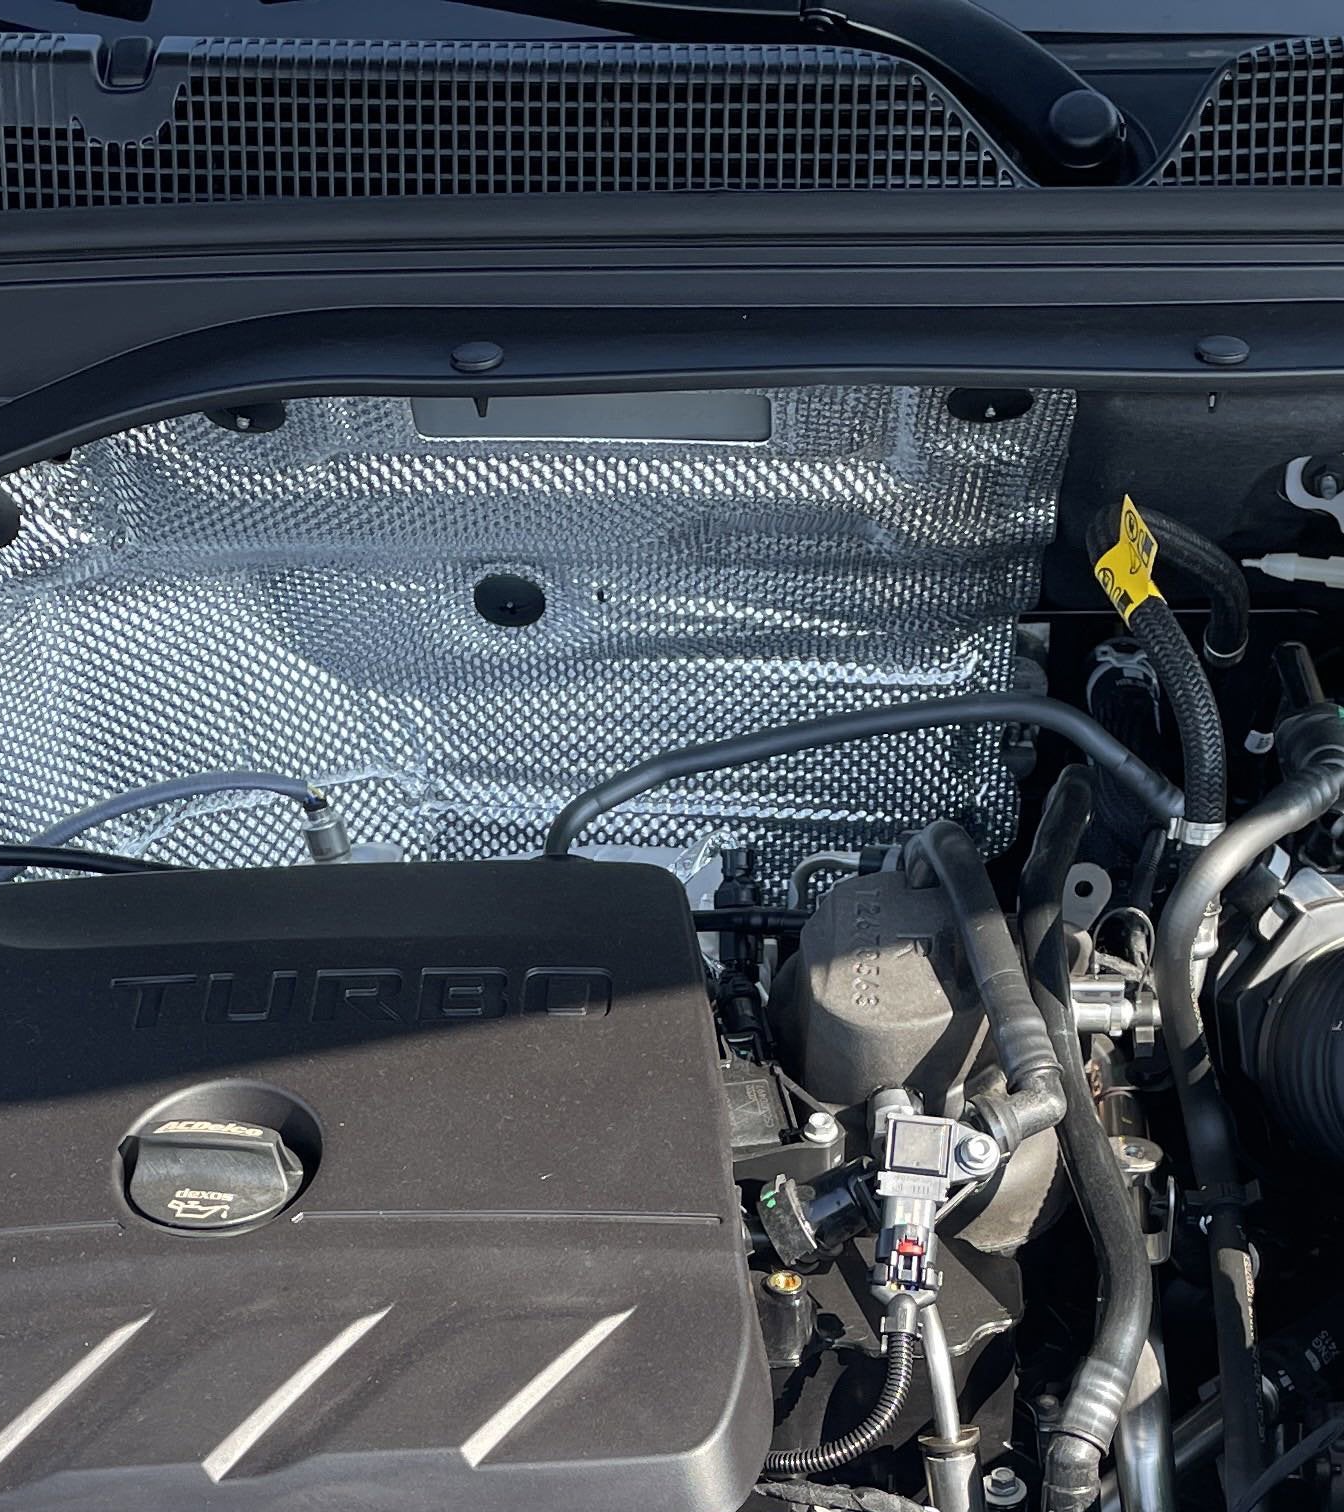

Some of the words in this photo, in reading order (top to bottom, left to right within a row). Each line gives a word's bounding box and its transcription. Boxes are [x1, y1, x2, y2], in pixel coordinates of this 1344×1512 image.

[111, 966, 613, 1030] TURBO
[152, 1121, 264, 1138] ACDelco
[175, 1188, 234, 1201] dexos
